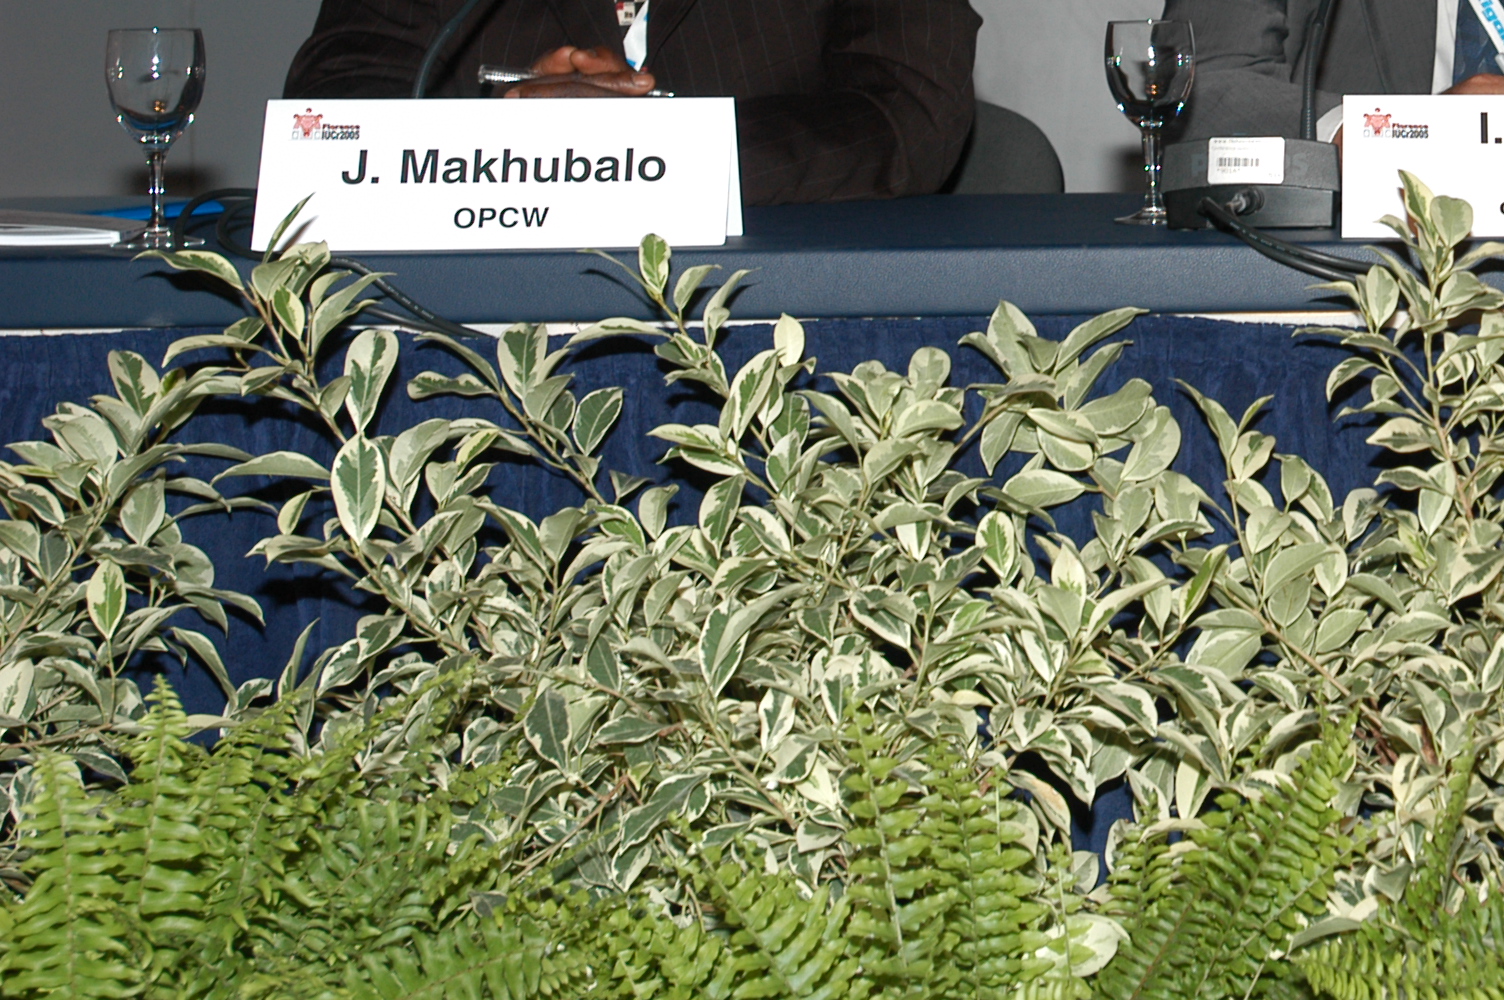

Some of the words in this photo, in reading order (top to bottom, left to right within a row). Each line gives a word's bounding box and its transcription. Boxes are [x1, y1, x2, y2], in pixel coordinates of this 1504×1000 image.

[322, 131, 360, 140] IUCr2005
[1480, 111, 1503, 144] I.
[341, 149, 380, 185] J.
[400, 148, 667, 185] Makhubalo
[453, 206, 550, 230] OPCW
